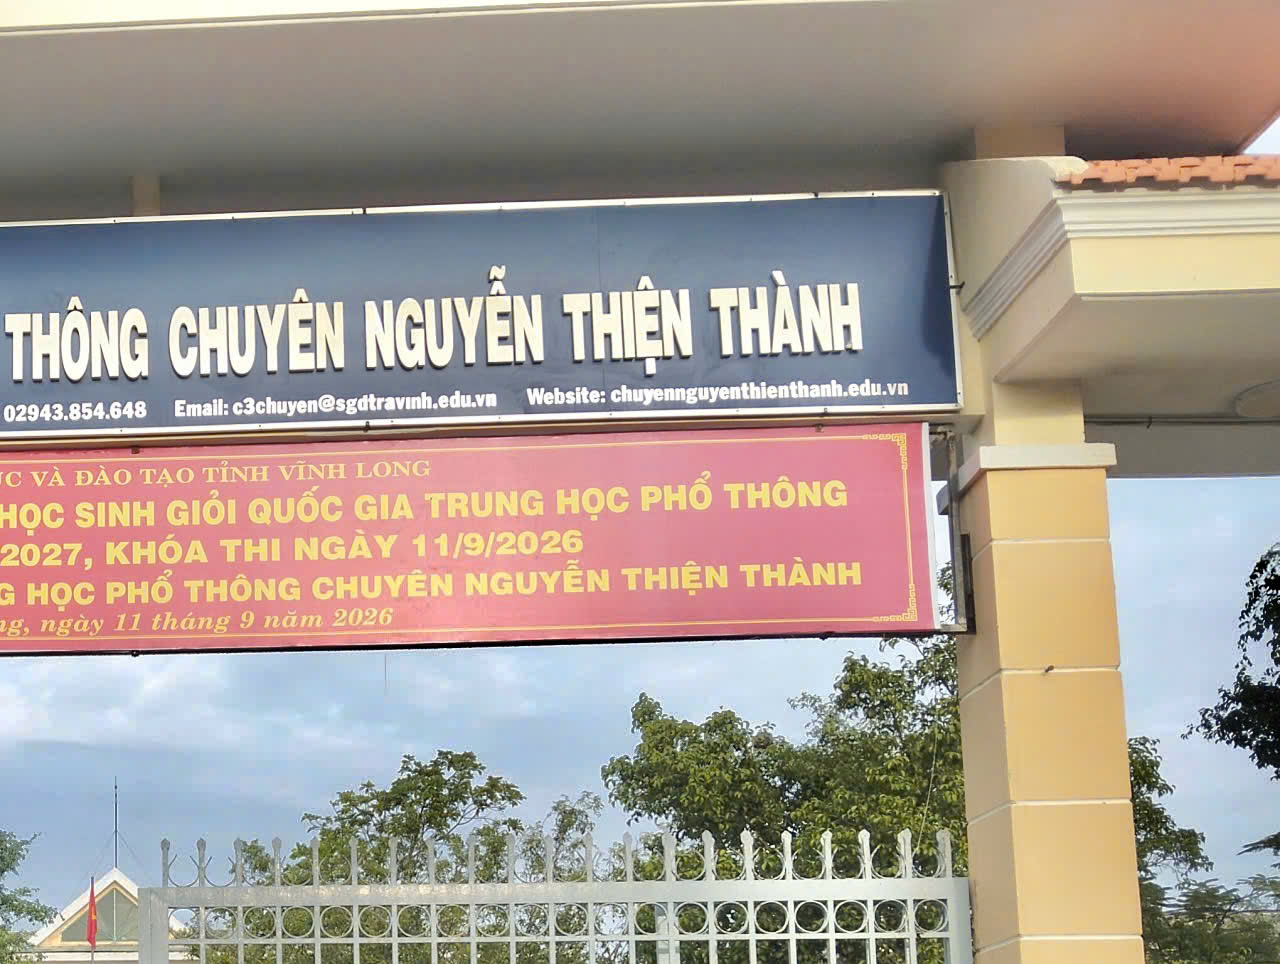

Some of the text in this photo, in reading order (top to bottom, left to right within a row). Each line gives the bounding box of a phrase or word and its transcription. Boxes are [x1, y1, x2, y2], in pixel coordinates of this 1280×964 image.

[4, 295, 149, 381] THÔNG
[168, 287, 346, 377] CHUYÊN
[364, 264, 545, 368] NGUYỄN
[562, 275, 694, 375] THIỆN
[709, 269, 864, 356] THÀNH
[174, 398, 230, 418] Email:
[526, 378, 909, 407] Website: chuyennguyenthienthanh.edu.vn
[3, 400, 148, 424] 02943.854.648
[29, 465, 66, 488] VÀ
[74, 464, 132, 487] ĐÀO
[139, 467, 195, 489] TẠO
[201, 459, 271, 484] TỈNH
[276, 459, 348, 481] VĨNH
[353, 457, 433, 482] LONG
[74, 500, 155, 529] SINH
[166, 488, 237, 527] GIỎI
[247, 484, 344, 526] QUỐC
[353, 491, 417, 522] GIA
[423, 487, 545, 521] TRUNG
[555, 485, 630, 522] HỌC
[639, 470, 713, 513] PHỔ
[722, 475, 848, 510] THÔNG
[0, 542, 93, 571] 2027,
[105, 533, 209, 565] KHÓA
[219, 537, 281, 563] THI
[293, 528, 401, 561] NGÀY
[412, 529, 584, 558] 11/9/2026
[27, 581, 95, 612] HỌC
[106, 568, 174, 605] PHỔ
[183, 573, 302, 603] THÔNG
[311, 569, 454, 600] CHUYÊN
[463, 559, 611, 597] NGUYỄN
[620, 560, 729, 596] THIỆN
[739, 556, 862, 588] THÀNH
[40, 614, 104, 637] ngày
[114, 613, 141, 631] 11
[151, 611, 231, 634] tháng
[239, 610, 255, 629] 9
[263, 609, 324, 629] năm
[331, 605, 396, 627] 2026
